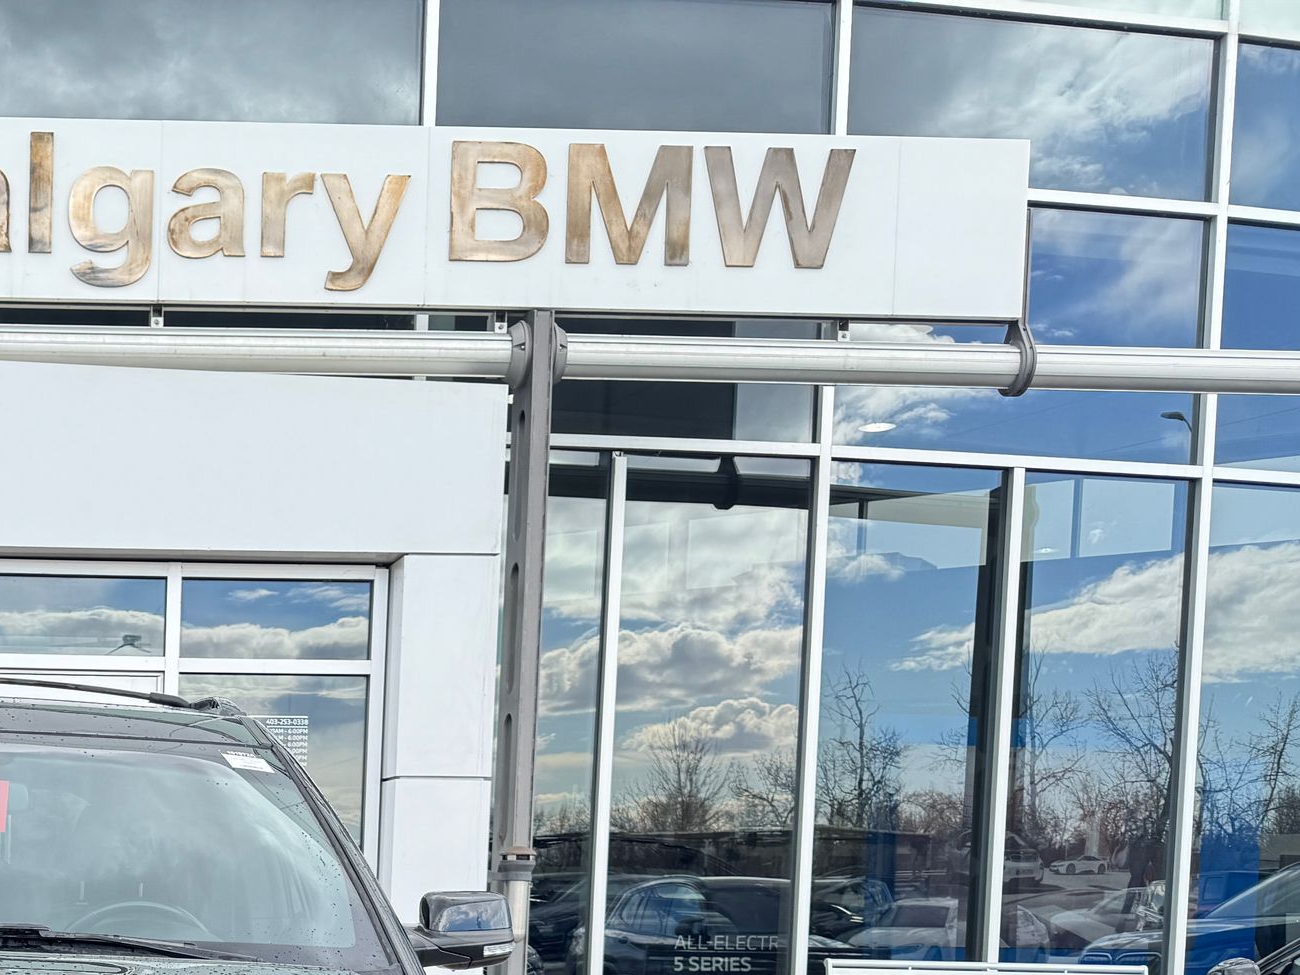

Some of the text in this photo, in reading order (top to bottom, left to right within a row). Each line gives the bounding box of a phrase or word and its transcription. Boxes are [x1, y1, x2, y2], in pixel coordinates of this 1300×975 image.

[448, 140, 856, 270] BMW
[674, 956, 752, 972] 5 SERIES
